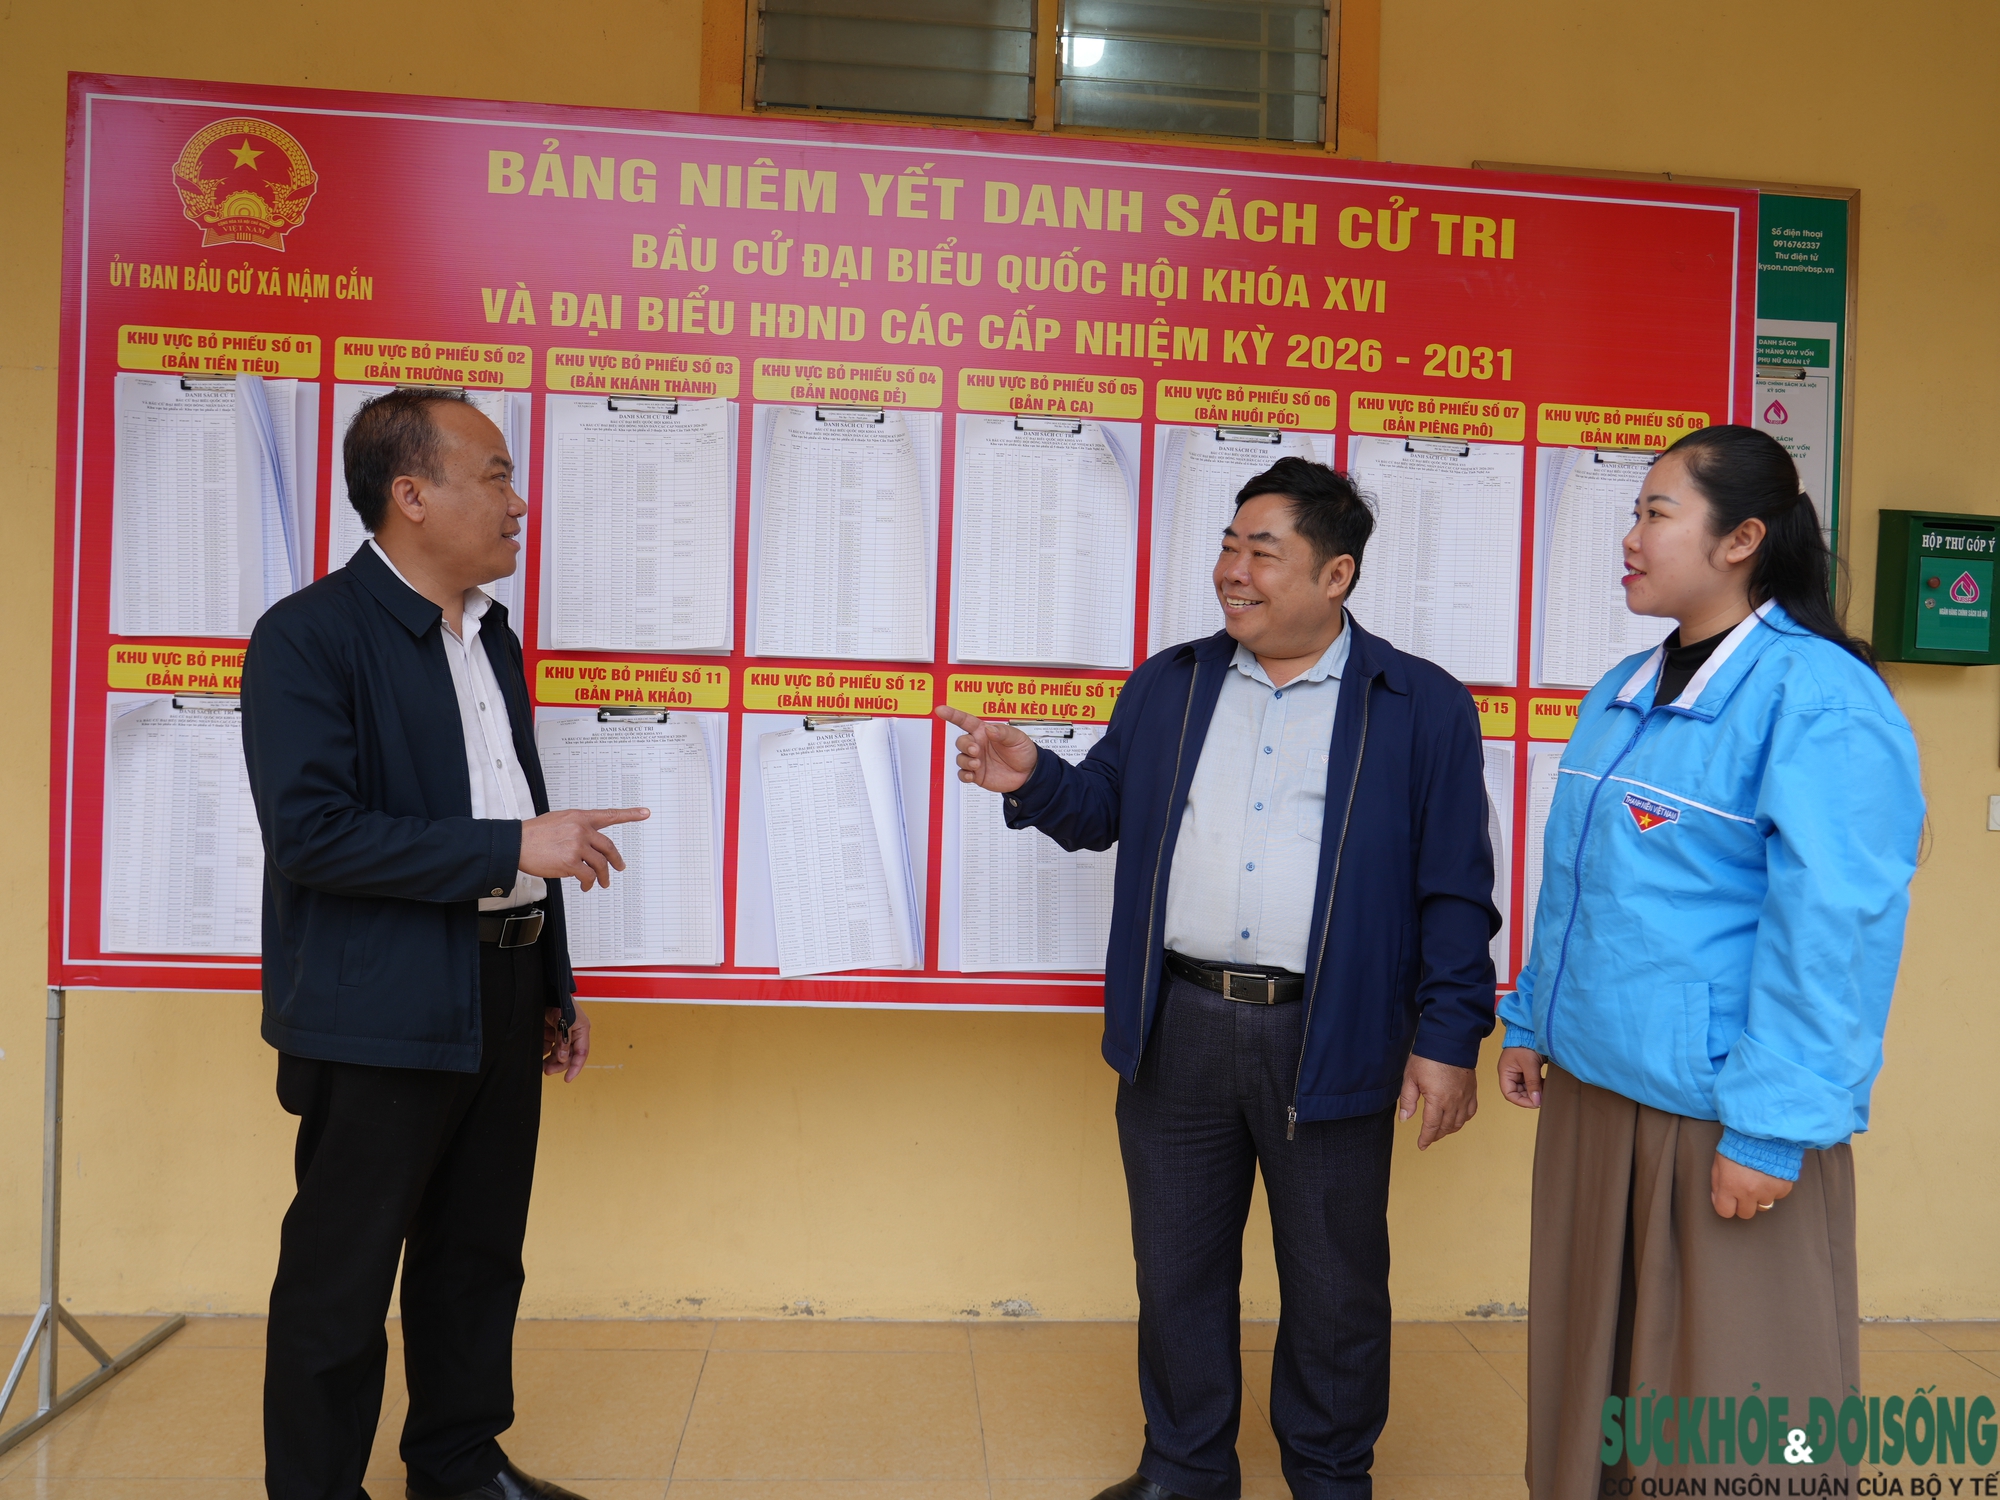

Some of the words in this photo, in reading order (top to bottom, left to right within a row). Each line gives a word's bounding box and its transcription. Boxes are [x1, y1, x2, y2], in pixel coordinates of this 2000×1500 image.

[487, 138, 657, 204] BẢNG
[680, 158, 837, 214] NIÊM
[859, 162, 964, 220] YẾT
[984, 181, 1142, 233] DANH
[1165, 189, 1317, 245] SÁCH
[1338, 195, 1419, 253] CỬ
[1431, 214, 1516, 260] TRI
[246, 226, 265, 234] NAM
[1771, 227, 1782, 235] Số
[1783, 229, 1800, 238] điện
[1803, 230, 1823, 239] thoại
[1773, 240, 1820, 249] 0916762337
[1791, 253, 1808, 262] điện
[1810, 253, 1819, 261] tử
[110, 254, 134, 286] ỦY
[139, 263, 178, 289] BAN
[184, 259, 221, 292] BẦU
[227, 262, 253, 294] CỬ
[257, 267, 281, 295] XÃ
[287, 269, 329, 302] NẬM
[335, 267, 373, 300] CẮN
[632, 224, 718, 273] BẦU
[732, 230, 794, 276] CỬ
[802, 243, 872, 288] ĐẠI
[887, 237, 982, 287] BIỂU
[997, 247, 1106, 294] QUỐC
[1121, 258, 1188, 306] HỘI
[1202, 266, 1310, 309] KHÓA
[1322, 277, 1387, 313] XVI
[481, 282, 536, 325] VÀ
[550, 292, 622, 336] ĐẠI
[638, 285, 735, 336] BIỂU
[750, 302, 865, 342] HĐND
[881, 304, 964, 347] CÁC
[978, 304, 1061, 351] CẤP
[1075, 318, 1208, 367] NHIỆM
[1223, 324, 1273, 366] KỲ
[1286, 334, 1381, 372] 2026
[1423, 344, 1512, 381] 2031
[127, 332, 158, 345] KHU
[164, 333, 192, 349] VỰC
[198, 332, 218, 348] BỎ
[223, 335, 266, 351] PHIẾU
[272, 337, 291, 352] SỐ
[296, 340, 312, 353] 01
[162, 352, 199, 369] (BẢN
[205, 354, 237, 371] TIỀN
[242, 356, 280, 374] TIÊU)
[364, 362, 400, 378] (BẢN
[406, 366, 463, 382] TRƯỜNG
[468, 371, 504, 384] SƠN)
[571, 372, 606, 388] (BẢN
[611, 373, 660, 392] KHÁNH
[665, 379, 716, 395] THÀNH)
[762, 364, 790, 377] KHU
[795, 365, 822, 381] VỰC
[827, 364, 845, 379] BỎ
[850, 367, 892, 382] PHIẾU
[896, 368, 915, 383] SỐ
[919, 372, 936, 384] 04
[791, 383, 825, 399] (BẢN
[830, 388, 879, 403] NOỌNG
[884, 387, 906, 404] DẺ)
[1009, 394, 1043, 410] (BẢN
[1048, 397, 1066, 411] PÀ
[1071, 400, 1093, 413] CA)
[1195, 404, 1227, 421] (BẢN
[1232, 406, 1263, 423] HUỒI
[1268, 408, 1300, 425] PỐC)
[1358, 398, 1384, 410] KHU
[1389, 399, 1414, 414] VỰC
[1418, 398, 1435, 413] BỎ
[1440, 401, 1478, 416] PHIẾU
[1483, 402, 1500, 417] SỐ
[1504, 407, 1519, 418] 07
[1383, 416, 1415, 432] (BẢN
[1420, 420, 1458, 434] PIÊNG
[1545, 409, 1572, 422] KHU
[1576, 411, 1600, 425] VỰC
[1604, 410, 1620, 425] BỎ
[1625, 412, 1662, 427] PHIẾU
[1667, 414, 1683, 428] SỐ
[1688, 418, 1703, 429] 08
[1581, 428, 1612, 443] (BẢN
[1616, 433, 1640, 445] KIM
[1644, 434, 1666, 447] ĐA)
[1922, 532, 1942, 550] HỘP
[1945, 536, 1965, 550] THƯ
[1966, 536, 1986, 552] GÓP
[1989, 537, 1996, 552] Ý
[117, 651, 147, 664] KHU
[153, 652, 181, 667] VỰC
[187, 650, 206, 666] BỎ
[146, 670, 184, 686] (BẢN
[188, 673, 218, 688] PHÀ
[955, 681, 982, 693] KHU
[987, 681, 1013, 696] VỰC
[1018, 680, 1036, 695] BỎ
[1041, 681, 1081, 696] PHIẾU
[1086, 682, 1104, 697] SỐ
[575, 685, 610, 701] (BẢN
[615, 687, 644, 702] PHÀ
[648, 686, 692, 704] KHẢO)
[777, 691, 812, 707] (BẢN
[817, 693, 849, 708] HUỒI
[854, 695, 898, 711] NHÚC)
[983, 698, 1016, 714] (BẢN
[1021, 701, 1047, 715] KÈO
[1052, 704, 1077, 718] LỰC
[1082, 705, 1095, 718] 2)
[1494, 703, 1508, 714] 15
[1535, 704, 1560, 716] KHU
[1625, 796, 1642, 808] THANH
[1653, 804, 1664, 816] VIỆT
[1663, 811, 1677, 819] NAM
